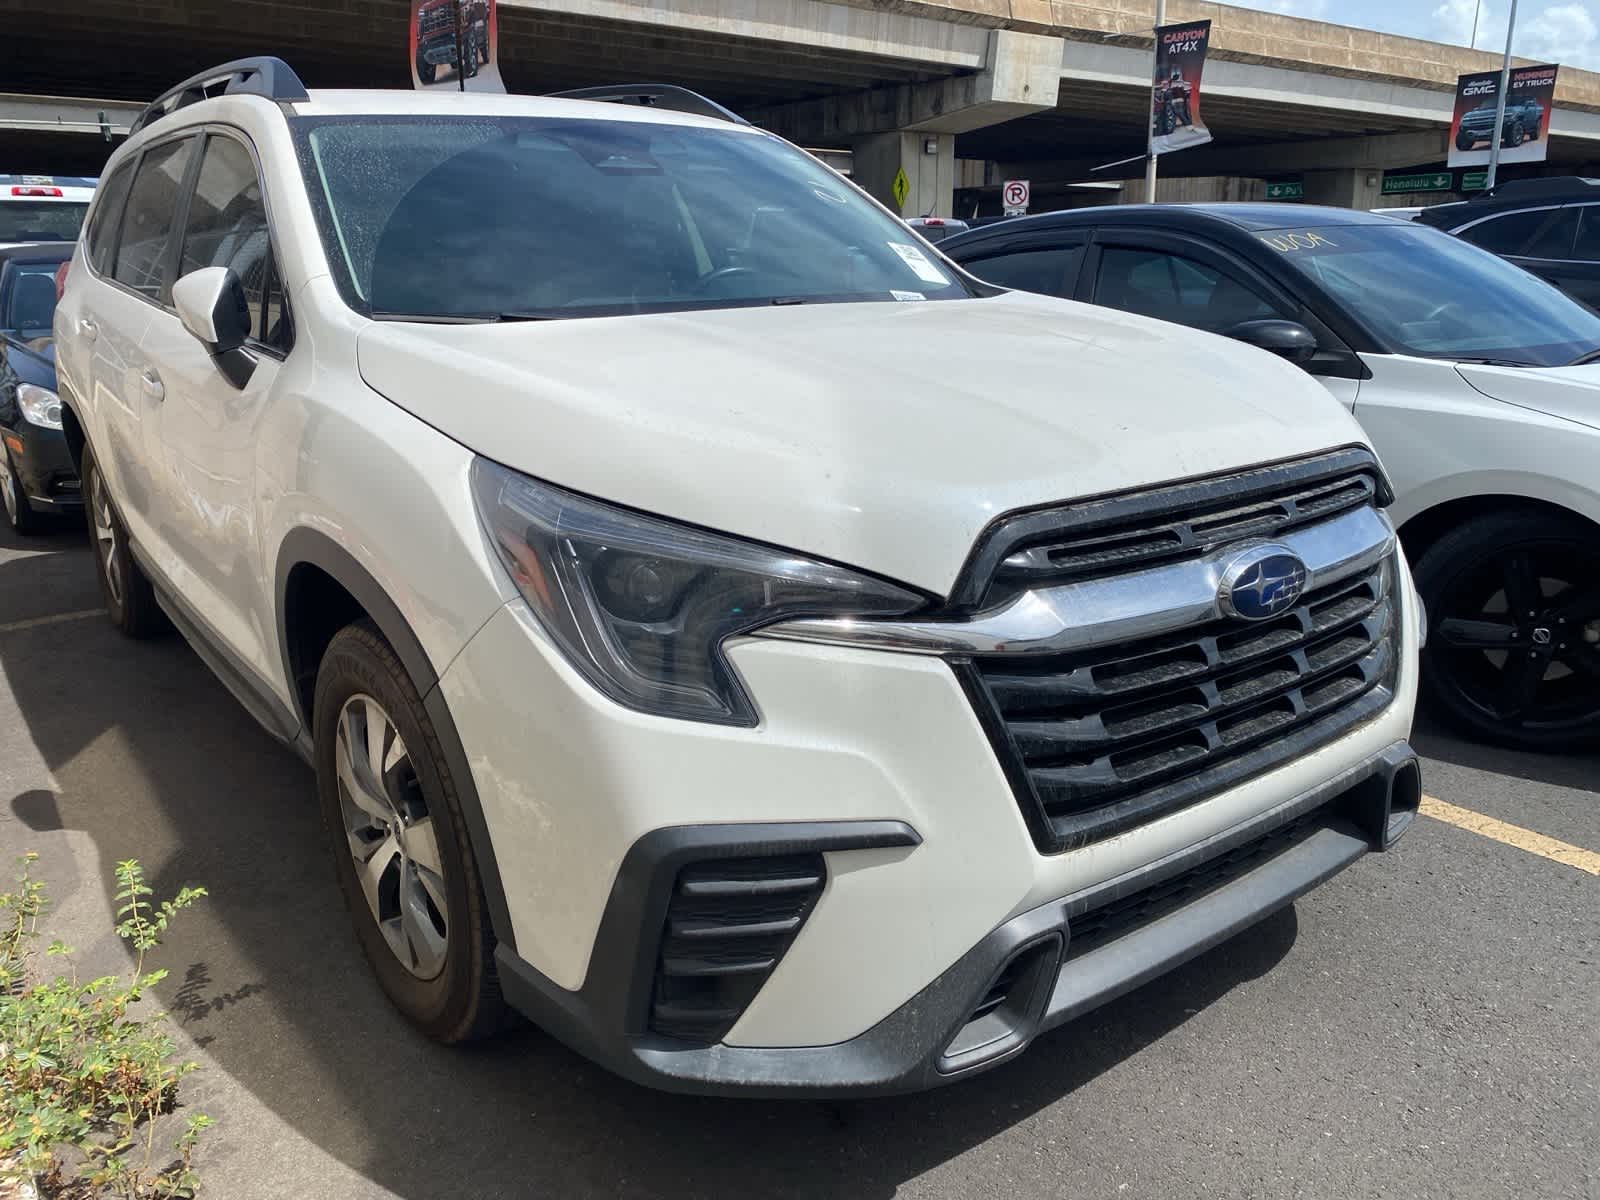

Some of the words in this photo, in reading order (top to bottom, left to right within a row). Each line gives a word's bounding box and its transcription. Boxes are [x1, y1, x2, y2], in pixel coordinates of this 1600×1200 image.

[1163, 29, 1206, 44] CANYON
[1168, 40, 1198, 55] AT4X
[1514, 69, 1556, 81] HUMMER
[1512, 81, 1525, 89] EV
[1526, 78, 1554, 88] TRUCK
[1463, 84, 1496, 96] GMC
[1385, 179, 1430, 190] Honolulu
